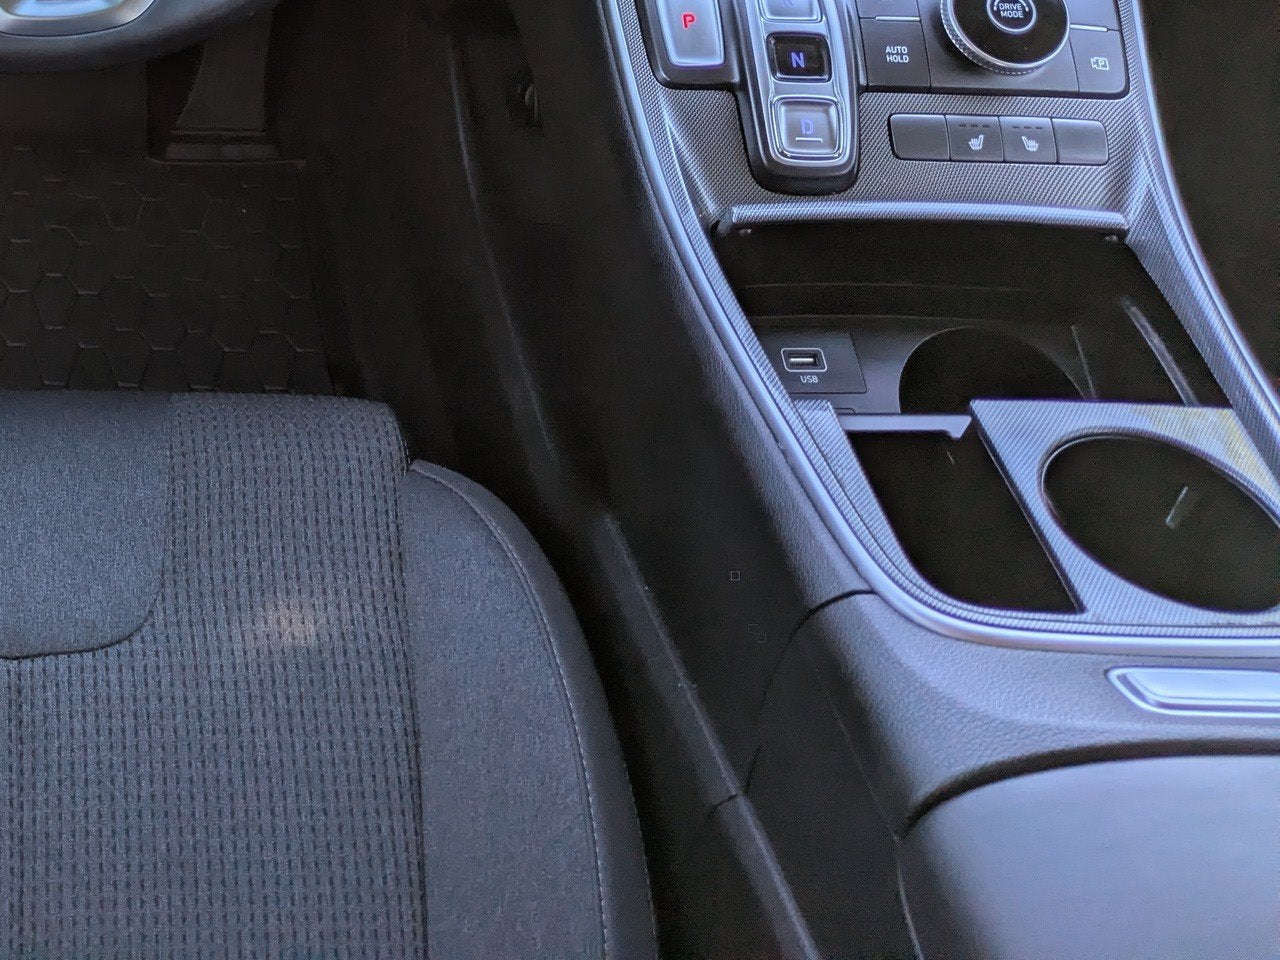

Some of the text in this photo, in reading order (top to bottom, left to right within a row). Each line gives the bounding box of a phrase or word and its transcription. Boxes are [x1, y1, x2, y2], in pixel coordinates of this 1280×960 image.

[998, 2, 1023, 11] DRIVE
[1000, 10, 1024, 19] MODE
[681, 12, 697, 29] P
[885, 45, 908, 54] AUTO
[790, 52, 805, 68] N
[886, 54, 910, 63] HOLD
[800, 118, 814, 136] D
[800, 375, 819, 383] USB
